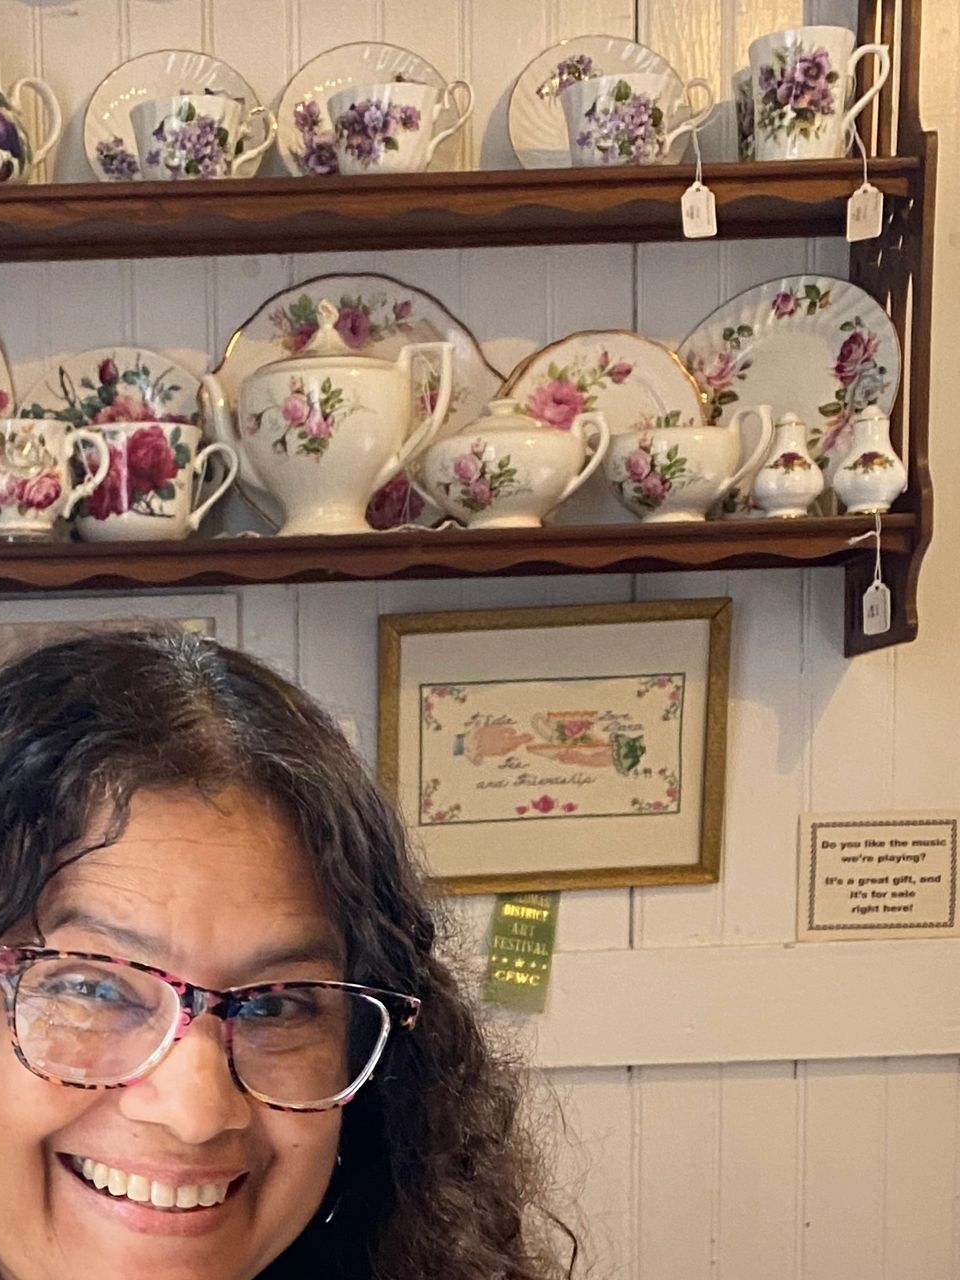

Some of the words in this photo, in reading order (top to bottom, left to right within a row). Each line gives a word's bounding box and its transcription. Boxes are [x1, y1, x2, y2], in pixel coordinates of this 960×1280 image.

[821, 840, 837, 849] Do
[840, 841, 861, 851] you
[864, 839, 886, 848] like
[889, 839, 908, 847] the
[911, 839, 947, 847] music
[841, 853, 874, 863] we're
[877, 852, 926, 864] playing?
[825, 876, 843, 885] It's
[846, 877, 855, 885] a
[858, 876, 889, 887] great
[892, 875, 916, 886] gift,
[919, 874, 942, 883] and
[871, 890, 888, 899] for
[891, 890, 916, 898] sale
[851, 905, 880, 915] right
[883, 904, 914, 912] here!
[511, 922, 536, 937] ART
[493, 935, 549, 956] FESTIVAL
